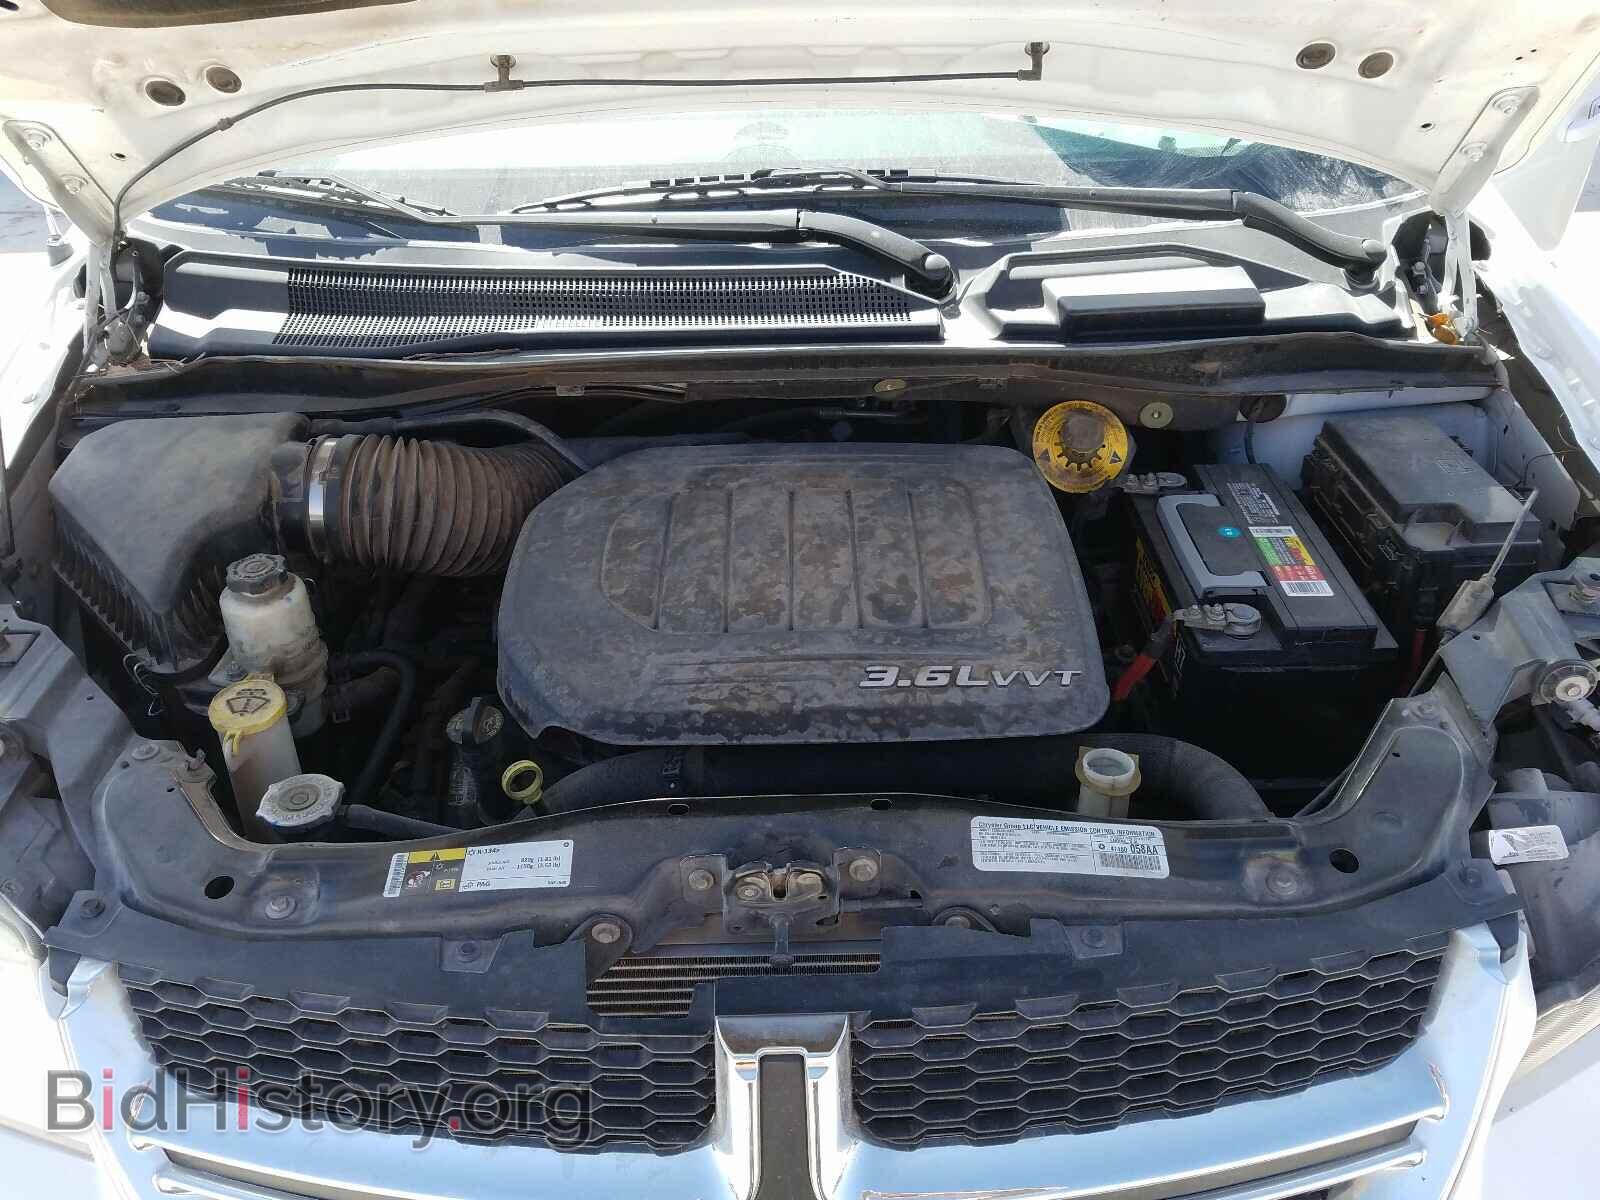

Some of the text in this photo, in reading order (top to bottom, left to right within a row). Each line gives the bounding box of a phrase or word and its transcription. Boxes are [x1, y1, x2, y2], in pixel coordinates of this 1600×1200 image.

[858, 664, 1082, 689] 3.6L VVT
[1003, 822, 1022, 831] Group
[1060, 825, 1088, 833] EMISSION
[1089, 828, 1115, 836] CONTROL
[1116, 829, 1155, 838] INFORMATION
[1129, 843, 1159, 856] 058AA
